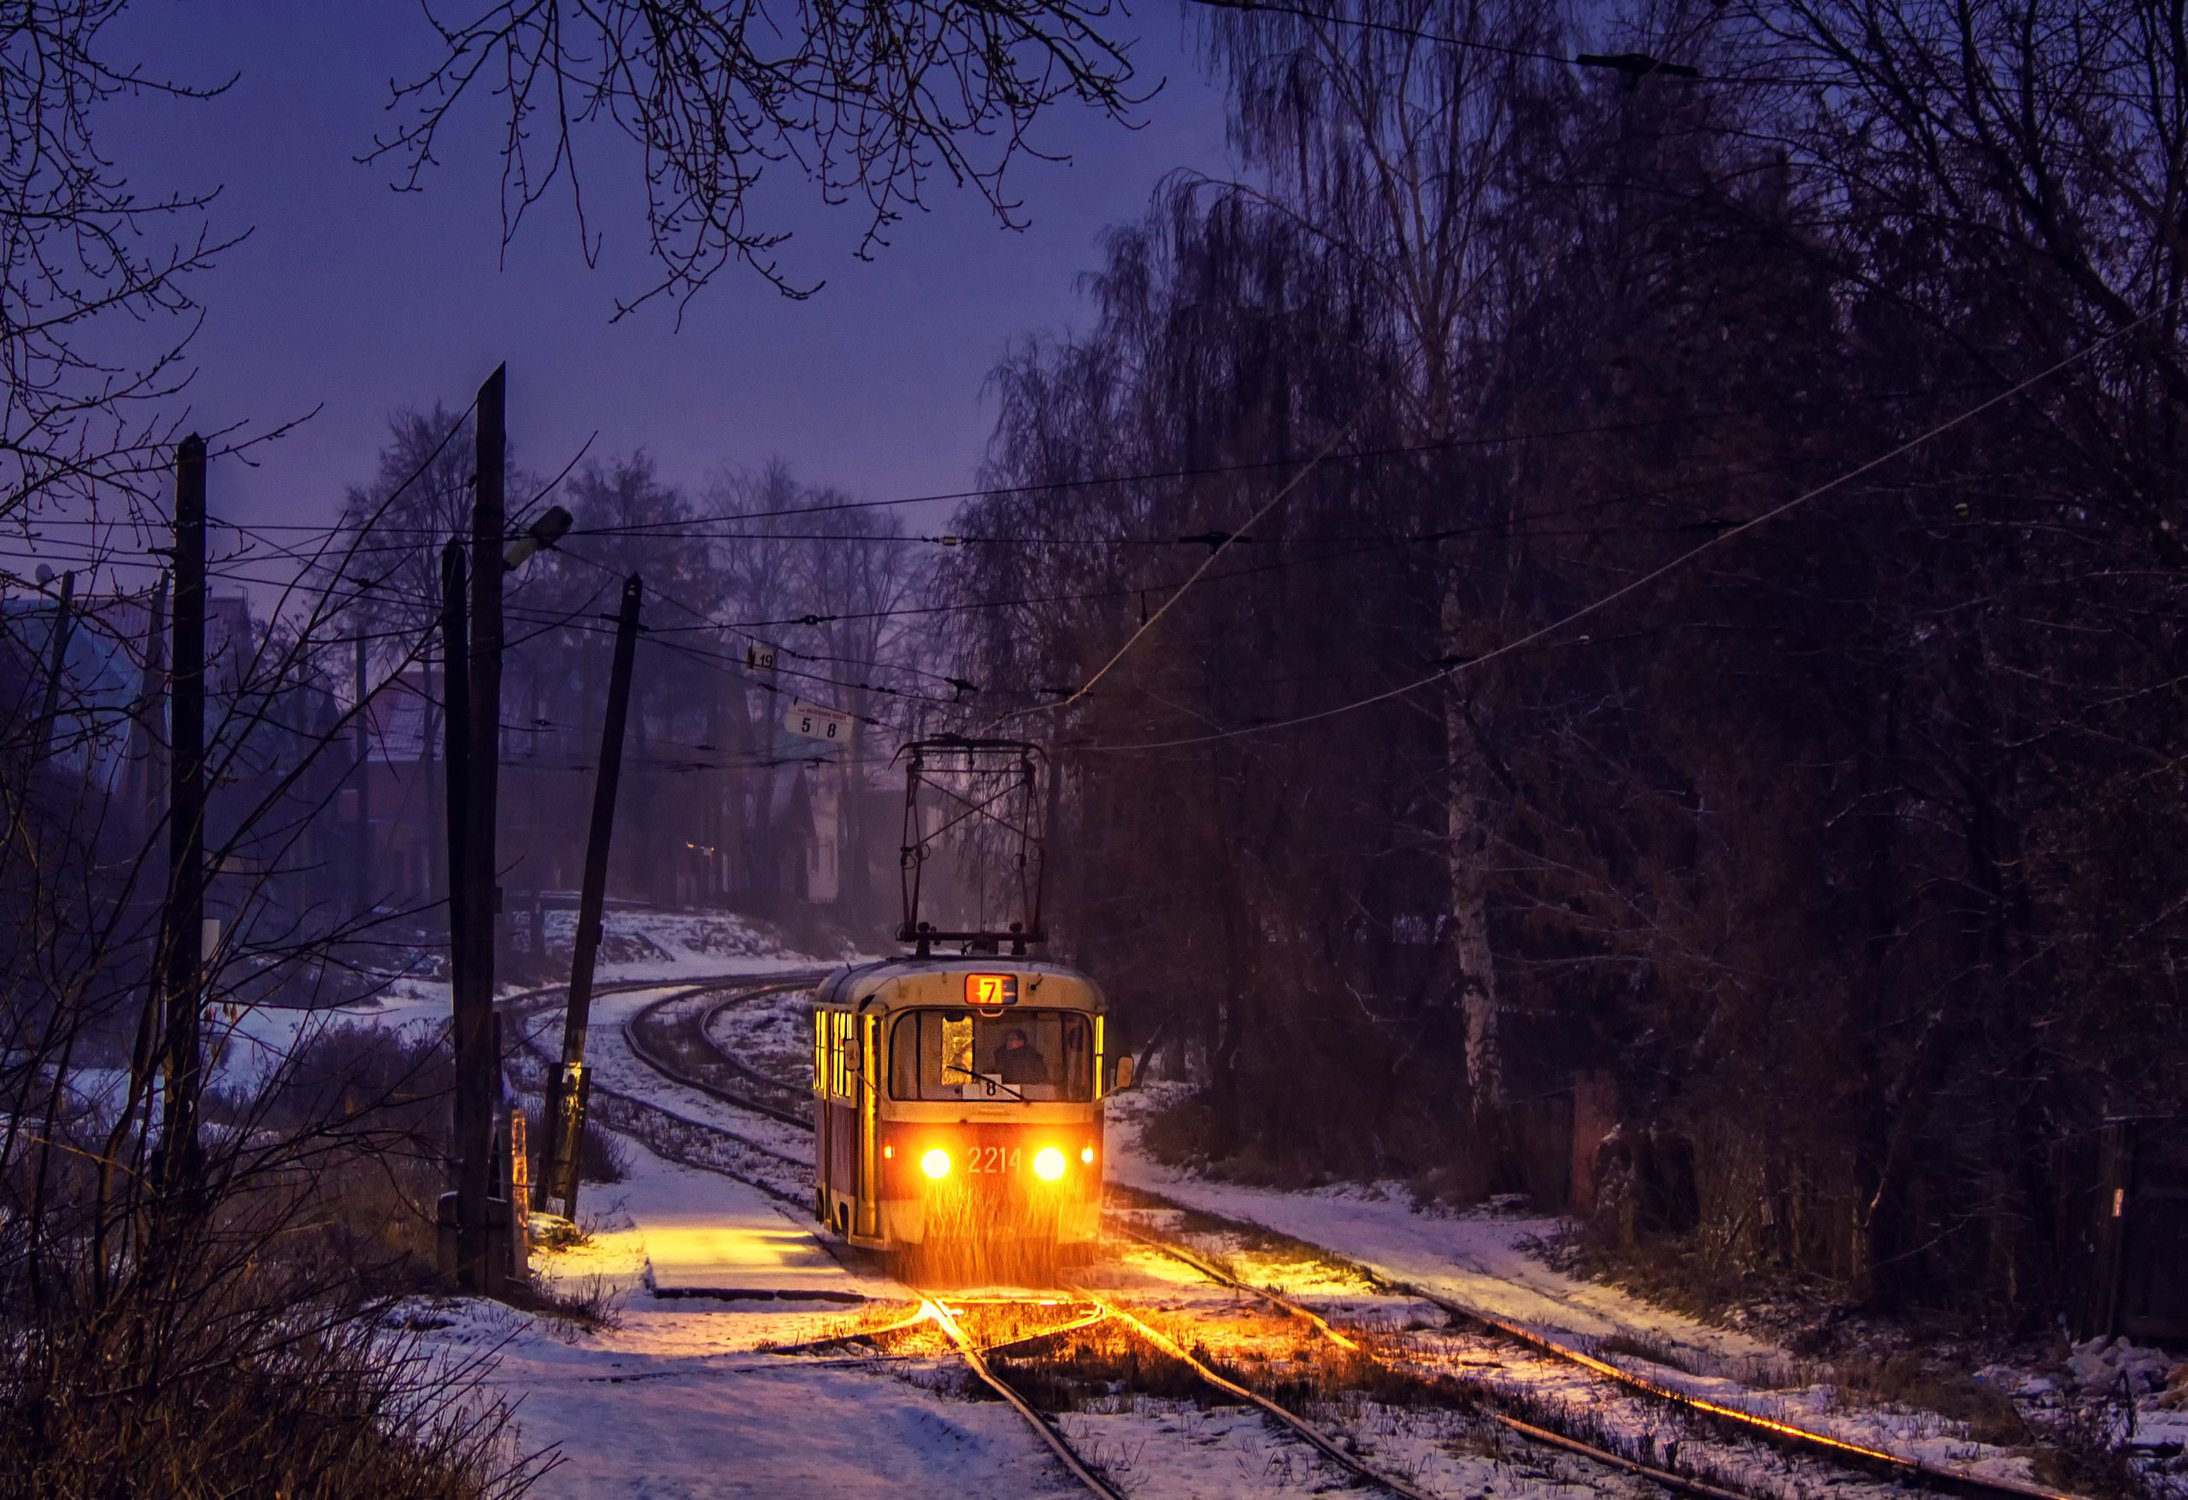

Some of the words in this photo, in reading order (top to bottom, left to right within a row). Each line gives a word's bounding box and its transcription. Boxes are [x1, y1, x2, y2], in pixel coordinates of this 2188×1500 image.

[760, 654, 773, 668] 19
[802, 717, 811, 733] 5
[827, 723, 837, 738] 8
[984, 981, 997, 1003] 7
[986, 1081, 996, 1096] 8
[968, 1146, 1022, 1174] 2214
